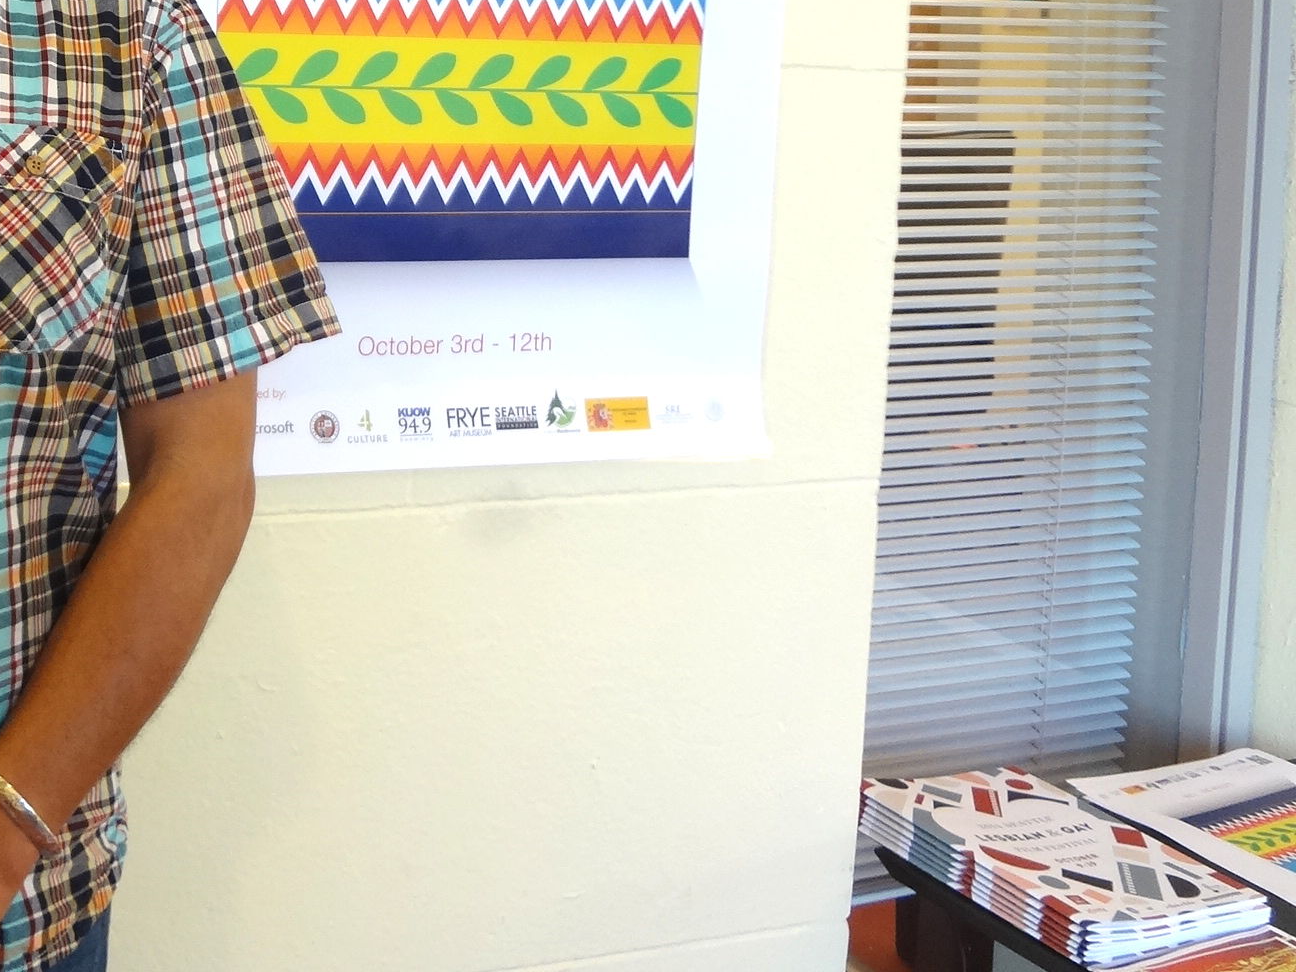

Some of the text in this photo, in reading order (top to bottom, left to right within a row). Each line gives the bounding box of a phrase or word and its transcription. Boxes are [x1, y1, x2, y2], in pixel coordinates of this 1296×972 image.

[358, 335, 443, 357] October
[450, 333, 484, 355] 3rd
[509, 332, 552, 353] 12th
[397, 407, 431, 417] KUOW
[446, 407, 492, 429] FRYE
[495, 406, 537, 418] SEATTLE
[398, 416, 432, 434] 94.9
[347, 435, 388, 444] CULTURE
[974, 831, 1047, 843] LESBIAN
[1060, 822, 1093, 834] GAY
